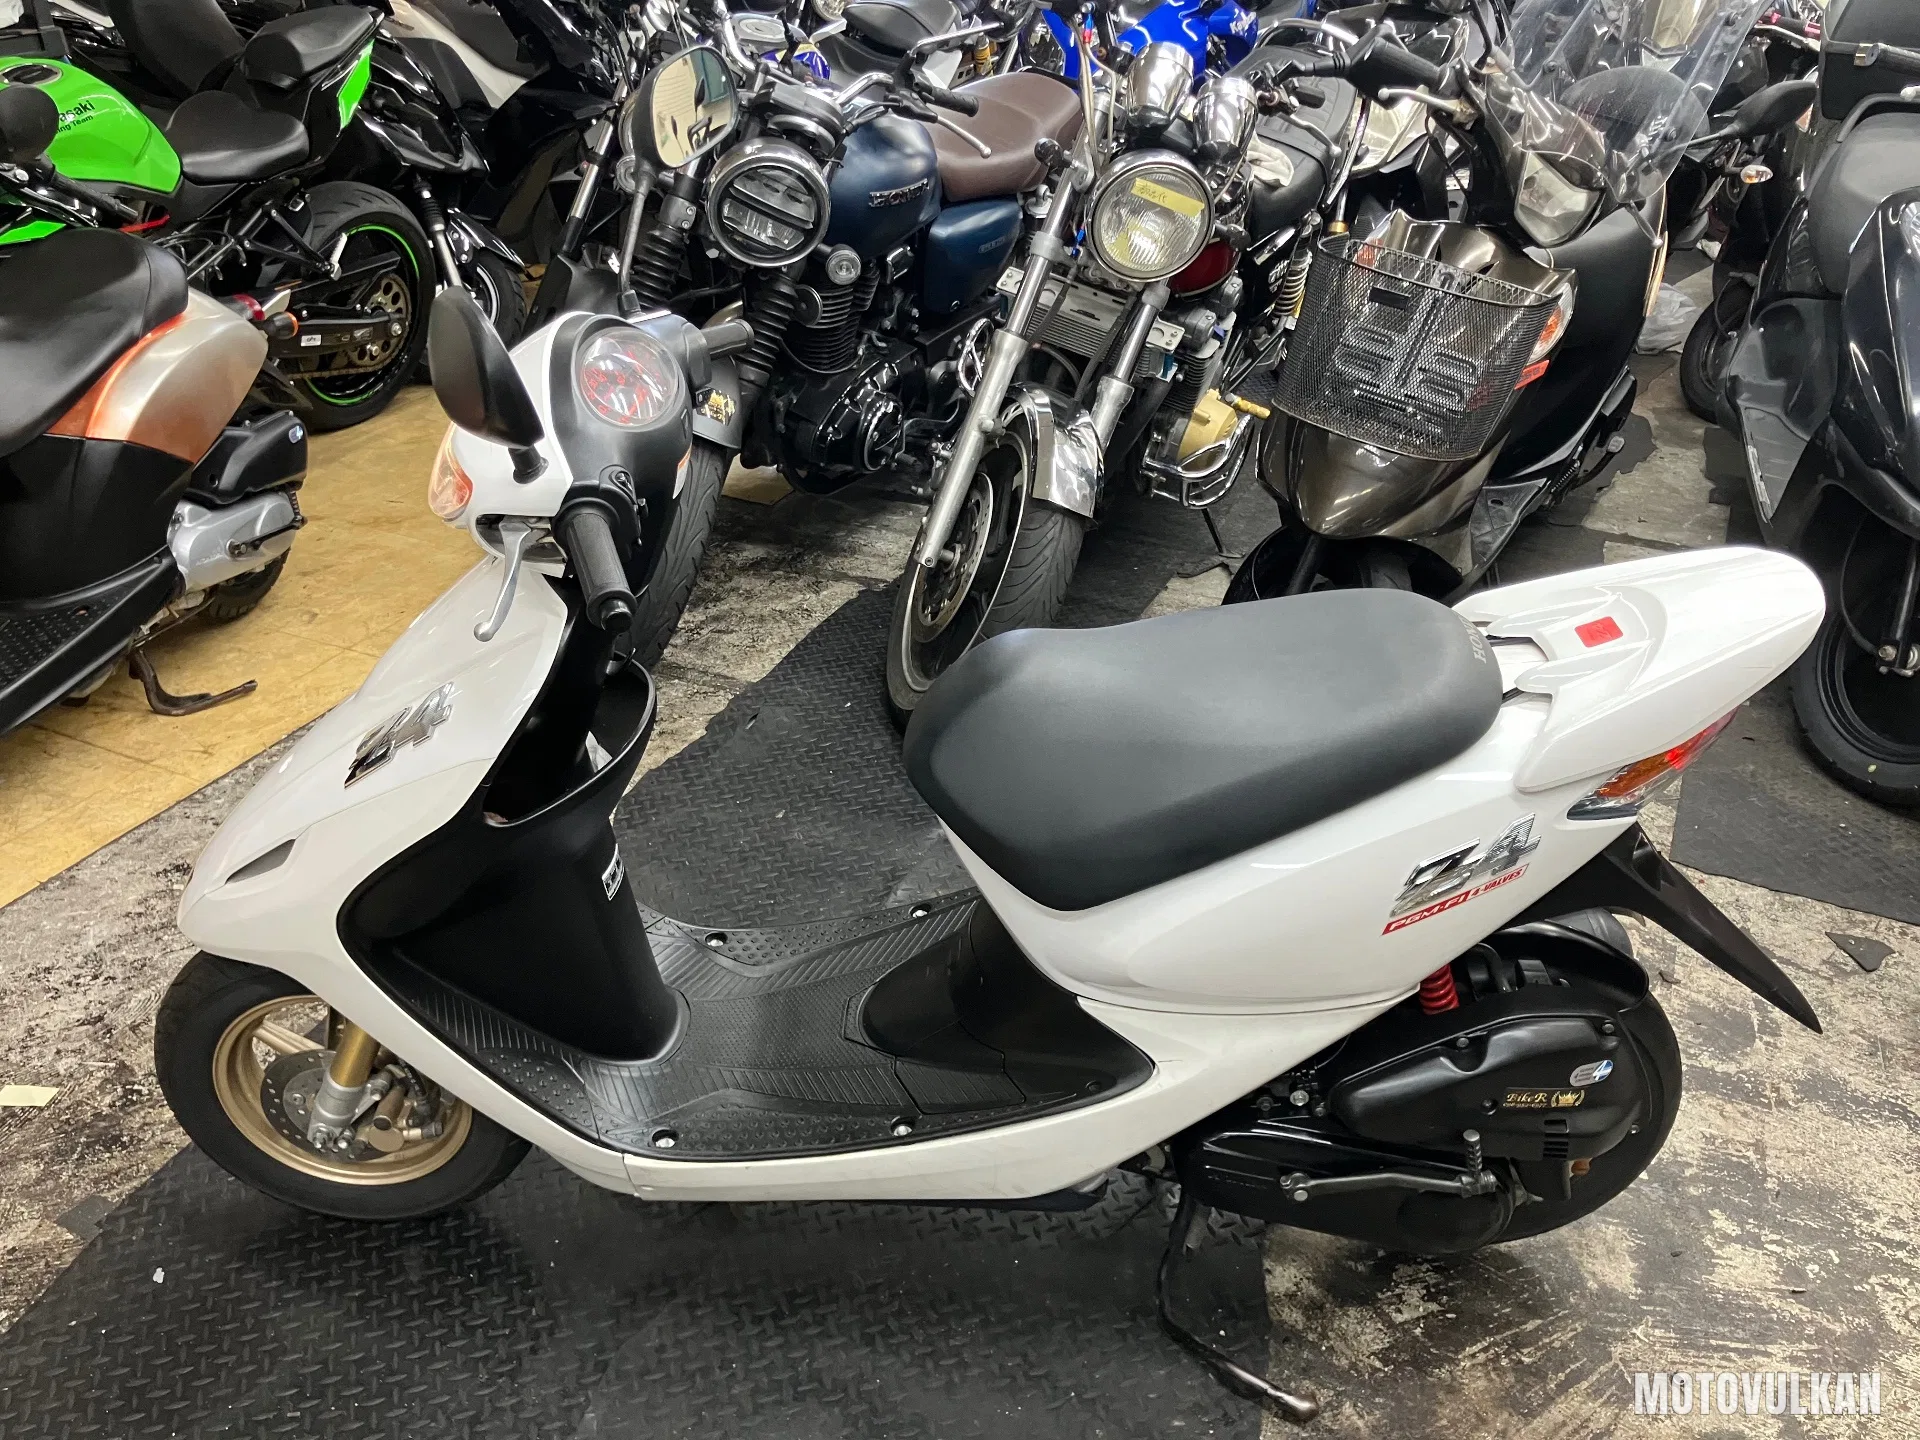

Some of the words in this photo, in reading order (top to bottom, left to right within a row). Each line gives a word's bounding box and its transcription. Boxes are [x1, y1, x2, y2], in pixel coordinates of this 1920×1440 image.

[59, 99, 96, 122] asaki
[72, 115, 94, 127] Team
[1471, 868, 1524, 898] 4-VALVES
